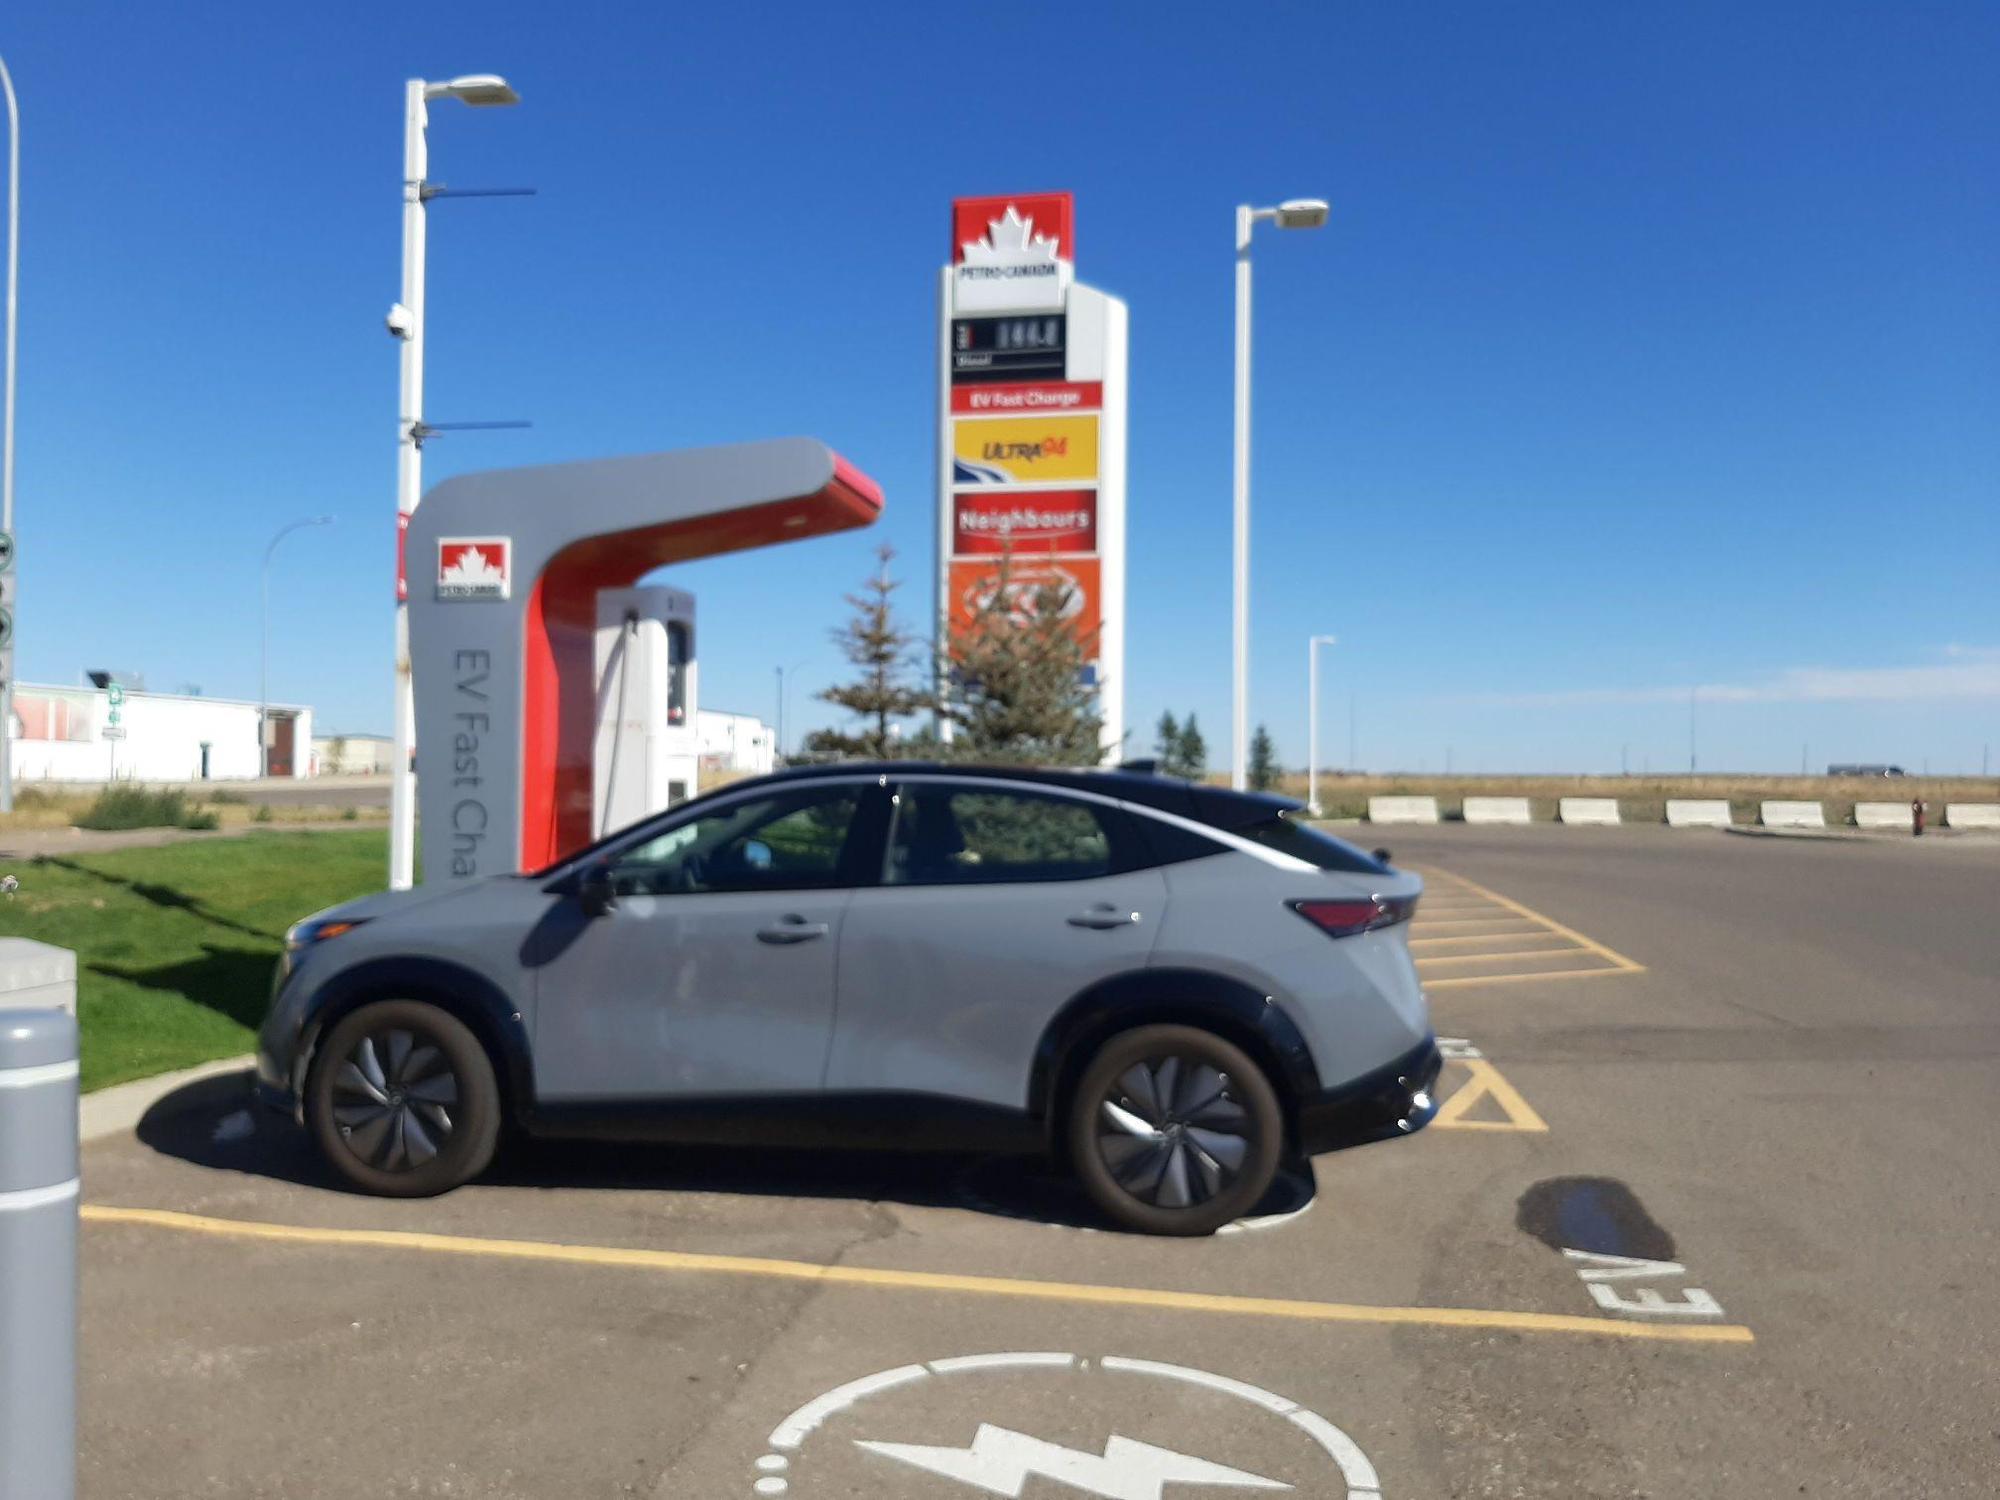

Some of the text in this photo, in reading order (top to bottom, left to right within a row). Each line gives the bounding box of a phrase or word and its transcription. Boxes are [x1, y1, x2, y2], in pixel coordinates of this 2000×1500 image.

[970, 390, 1080, 408] EV Fast Charge
[958, 508, 1090, 533] Neighbours
[451, 650, 490, 878] EV Fast Cha
[1561, 1247, 1724, 1315] EV
